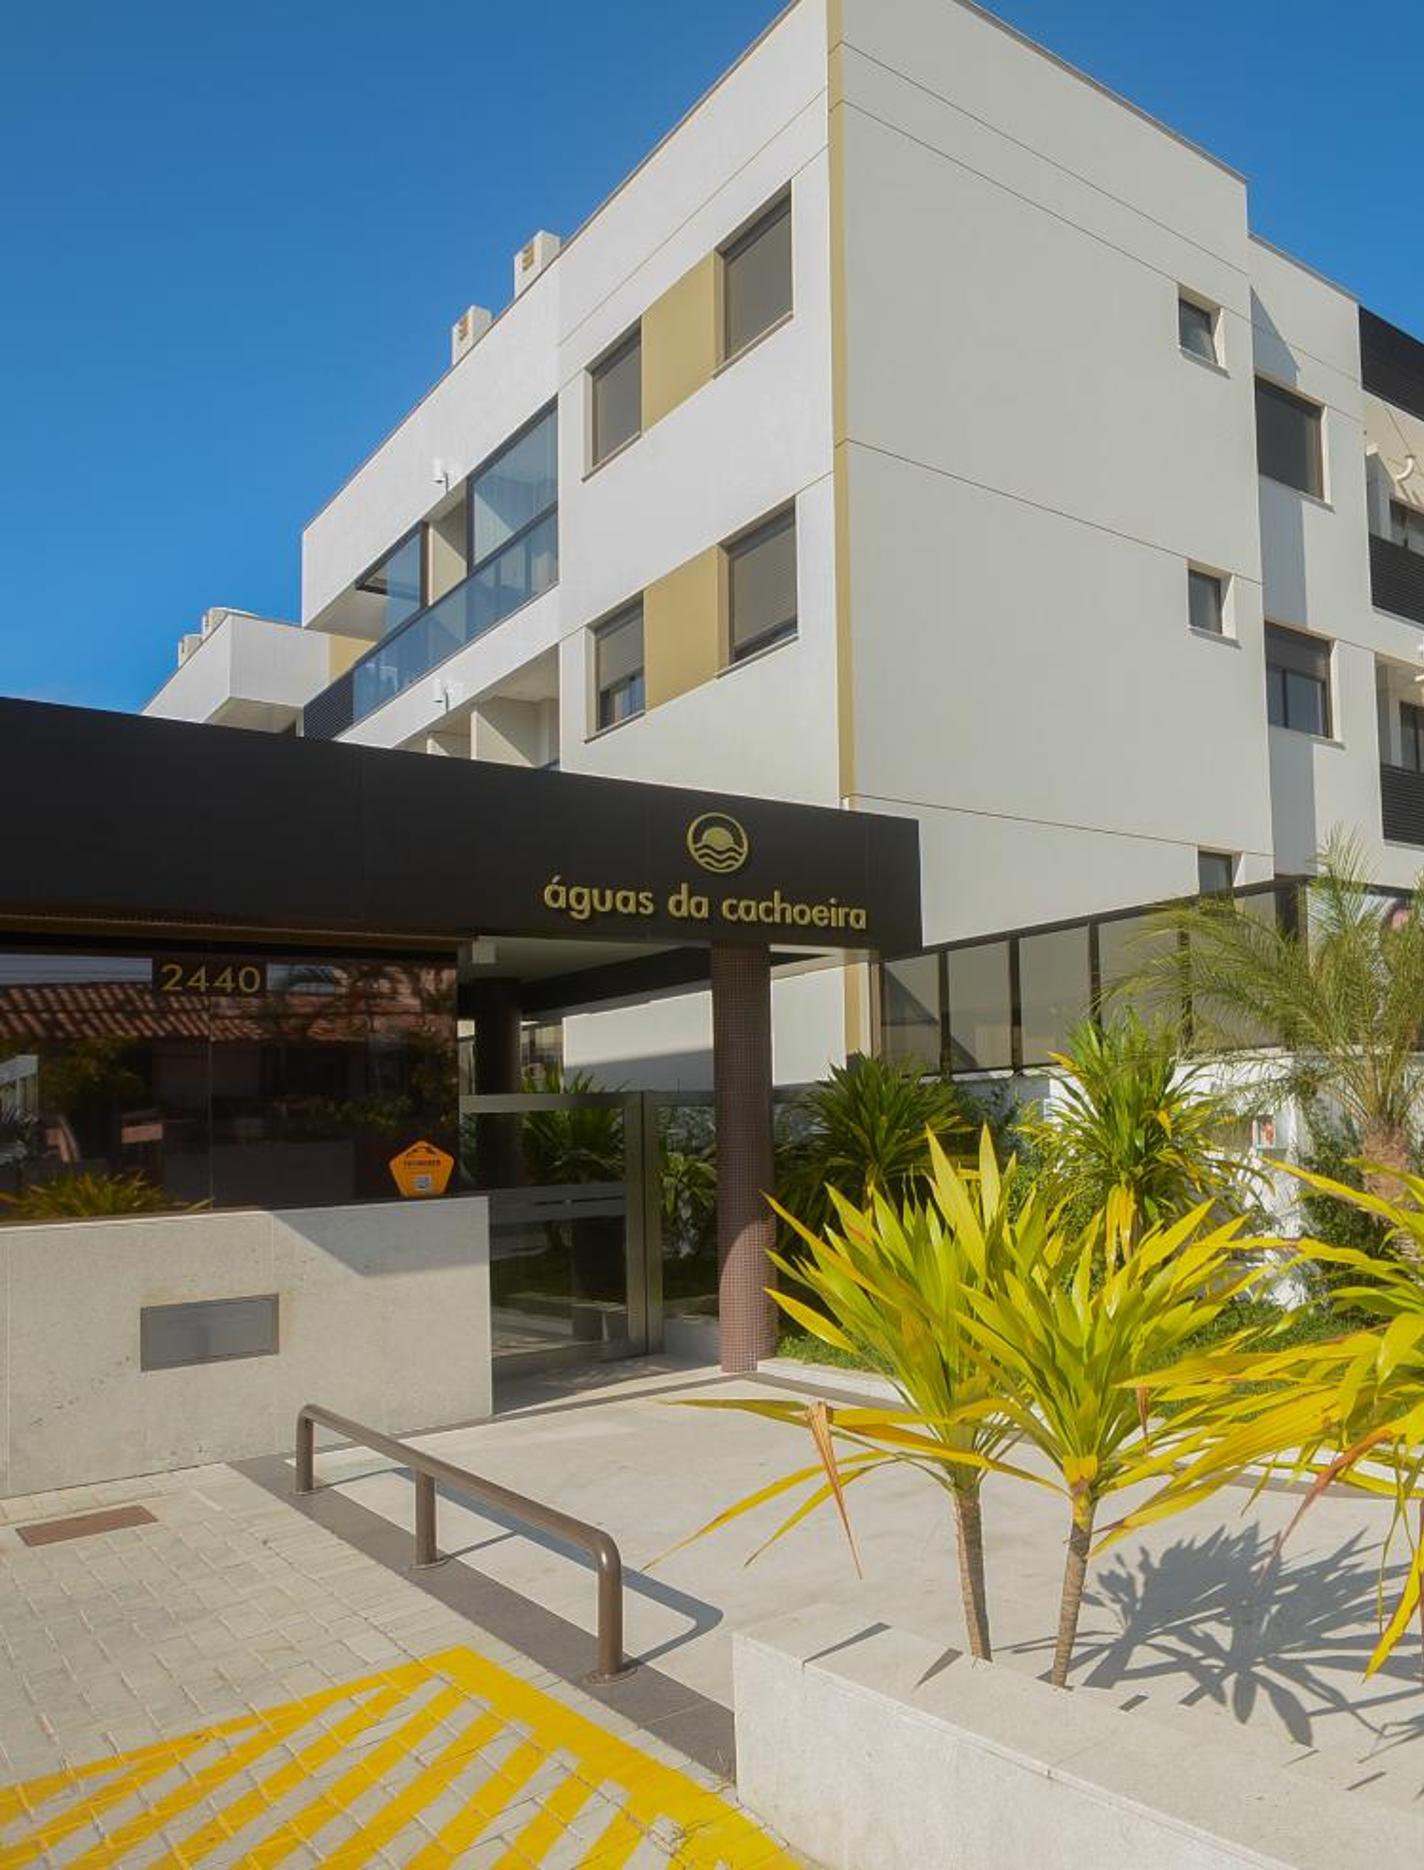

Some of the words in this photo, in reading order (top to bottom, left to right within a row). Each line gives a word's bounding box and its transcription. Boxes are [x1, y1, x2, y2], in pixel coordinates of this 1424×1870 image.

[543, 875, 653, 919] águas
[667, 883, 710, 919] da
[721, 890, 866, 929] cachoeira
[161, 964, 260, 992] 2440
